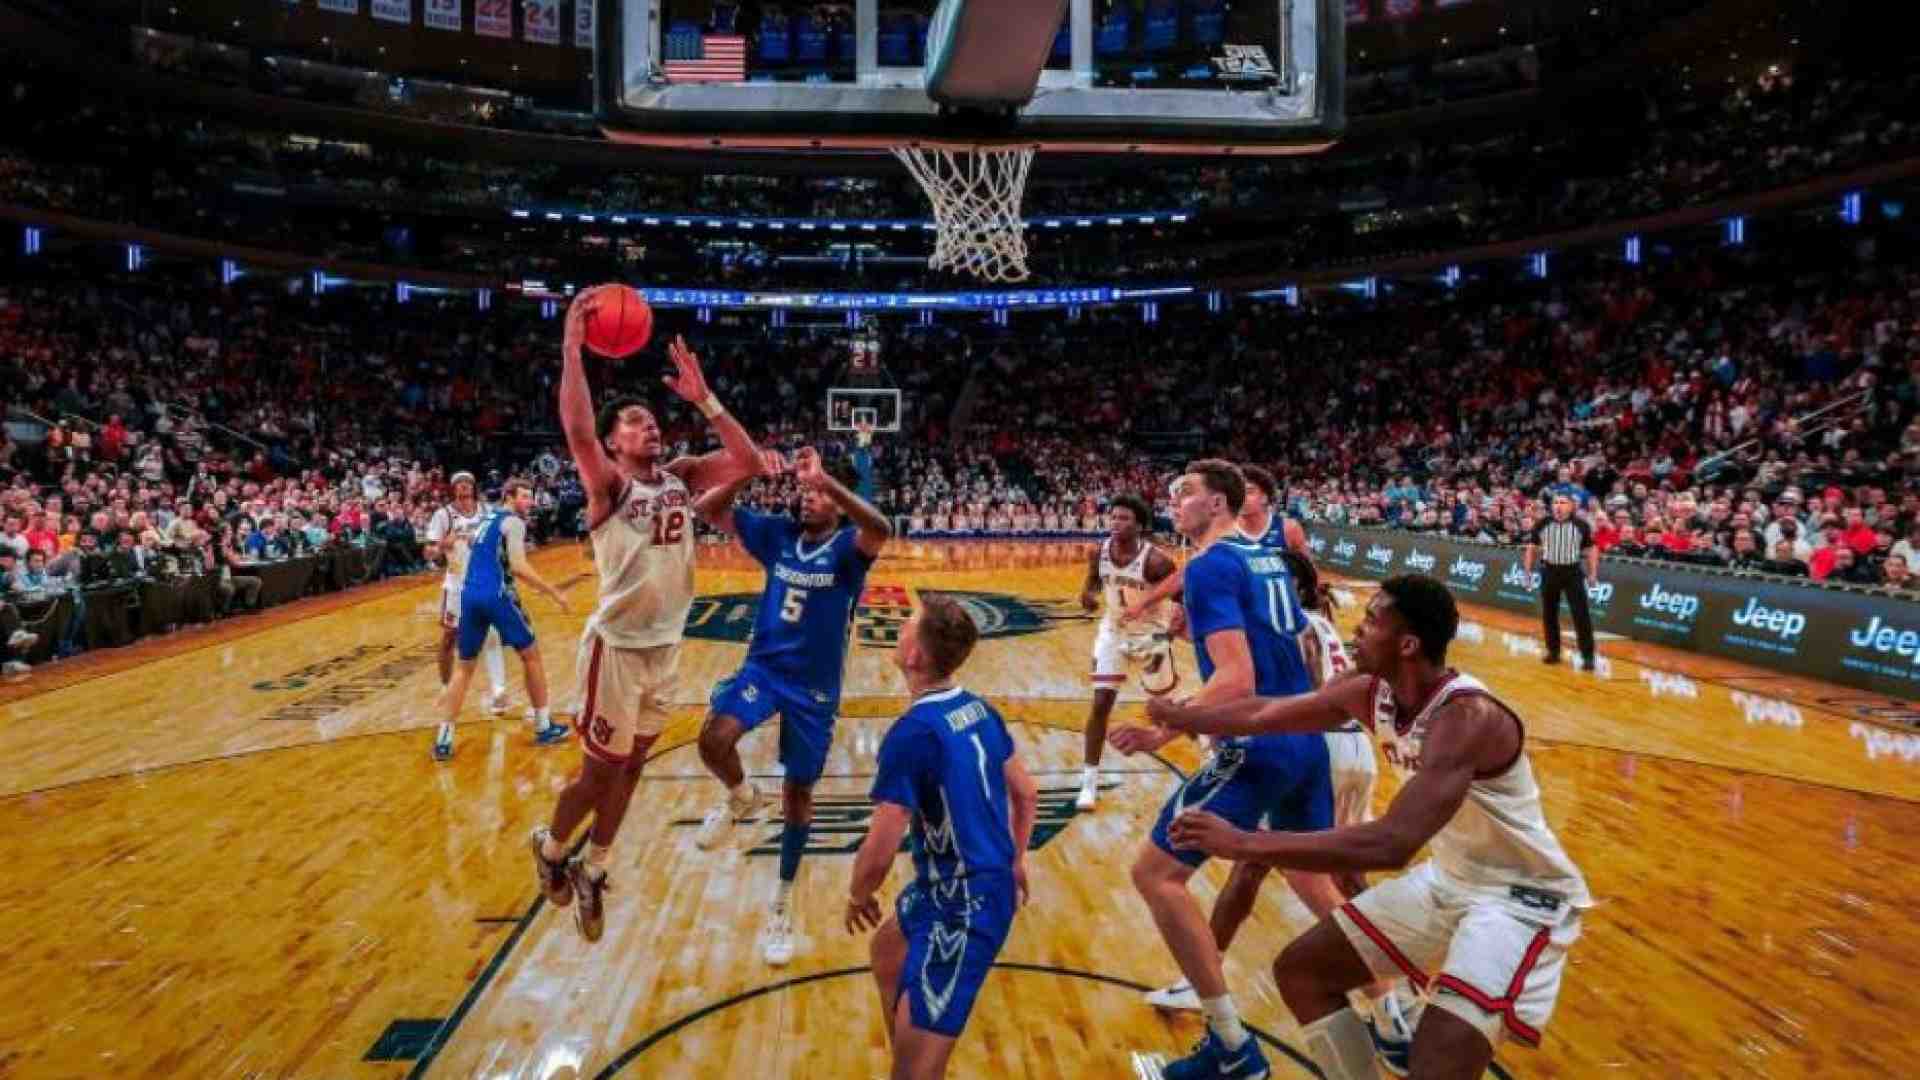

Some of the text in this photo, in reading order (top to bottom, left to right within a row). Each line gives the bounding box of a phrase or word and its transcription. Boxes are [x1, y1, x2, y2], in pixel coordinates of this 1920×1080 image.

[650, 511, 684, 546] 12
[1405, 547, 1436, 573] Jeep
[1449, 552, 1486, 582] Jeep
[780, 588, 808, 623] 5
[1640, 583, 1698, 620] Jeep
[1733, 597, 1806, 638] Jeep
[969, 732, 992, 802] 1
